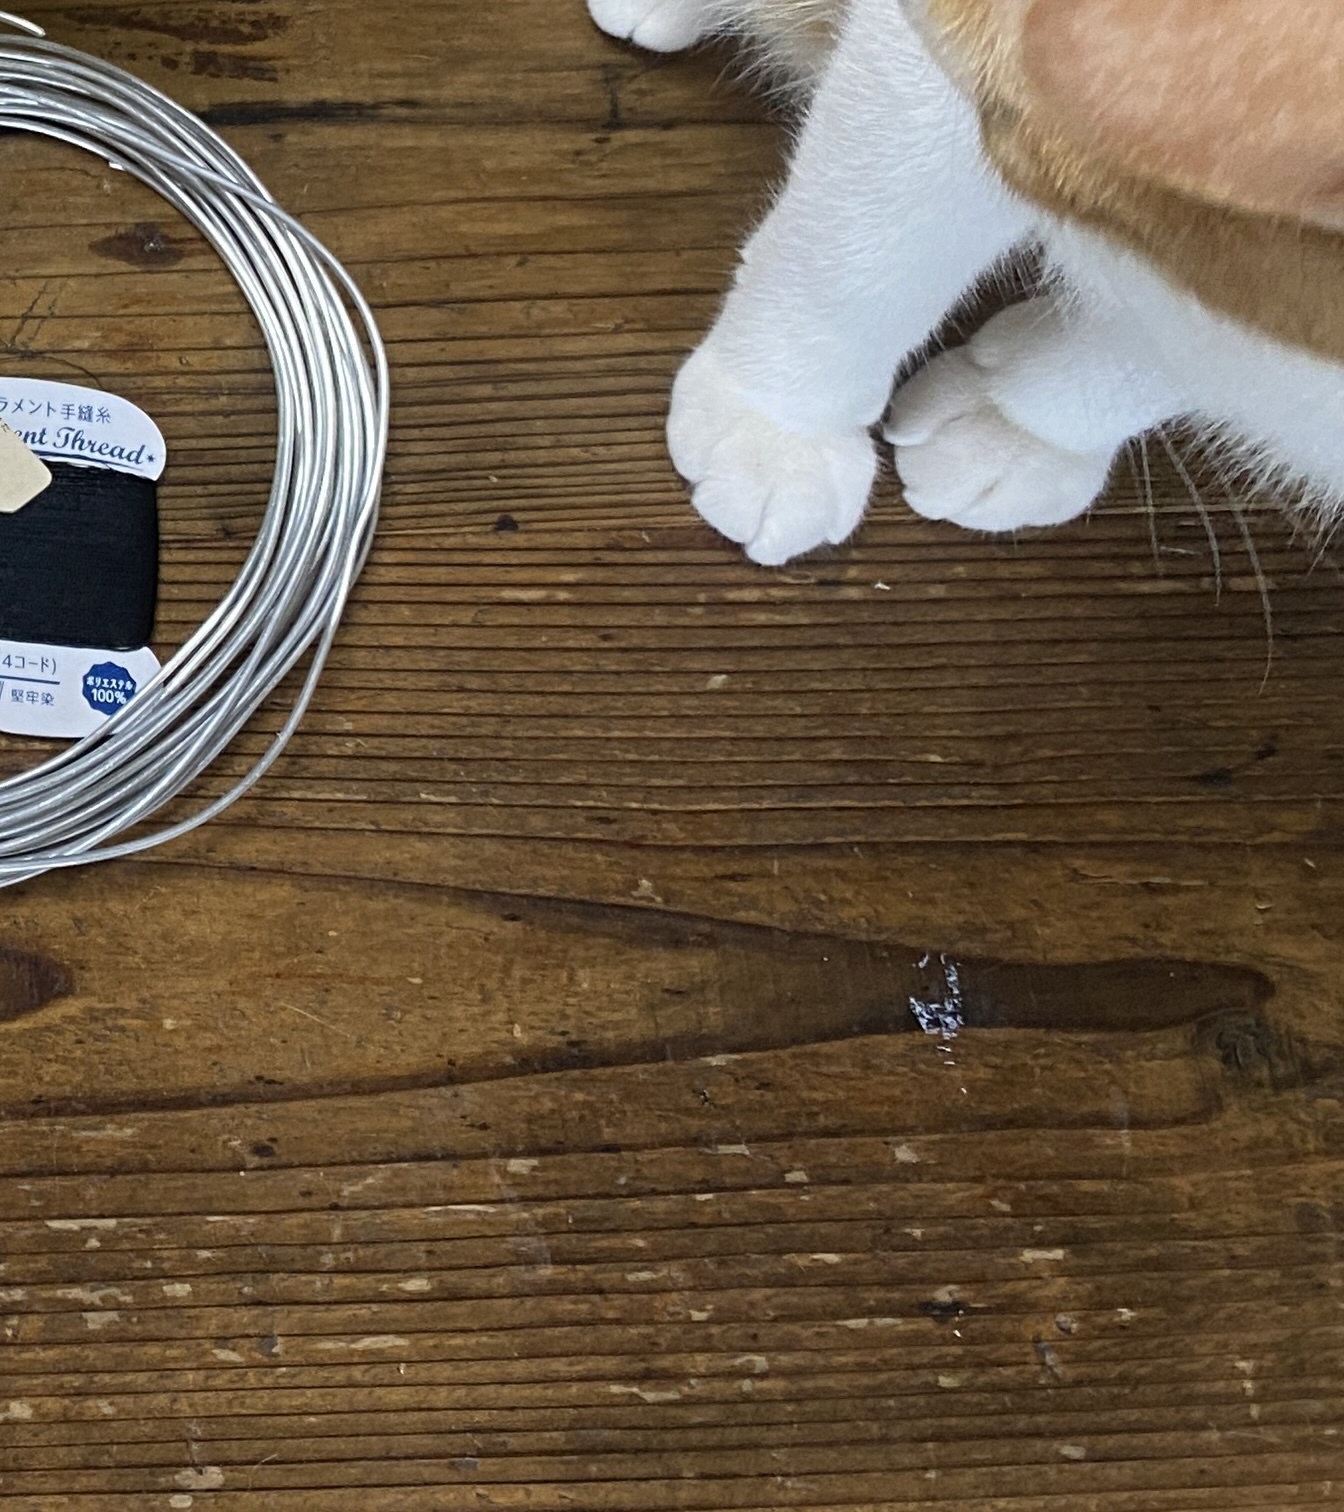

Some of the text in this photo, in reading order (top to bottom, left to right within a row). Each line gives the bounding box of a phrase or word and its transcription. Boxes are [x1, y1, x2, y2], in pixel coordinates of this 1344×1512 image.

[52, 426, 146, 465] Thread
[86, 674, 134, 692] ポリエステル
[90, 688, 127, 705] 100%
